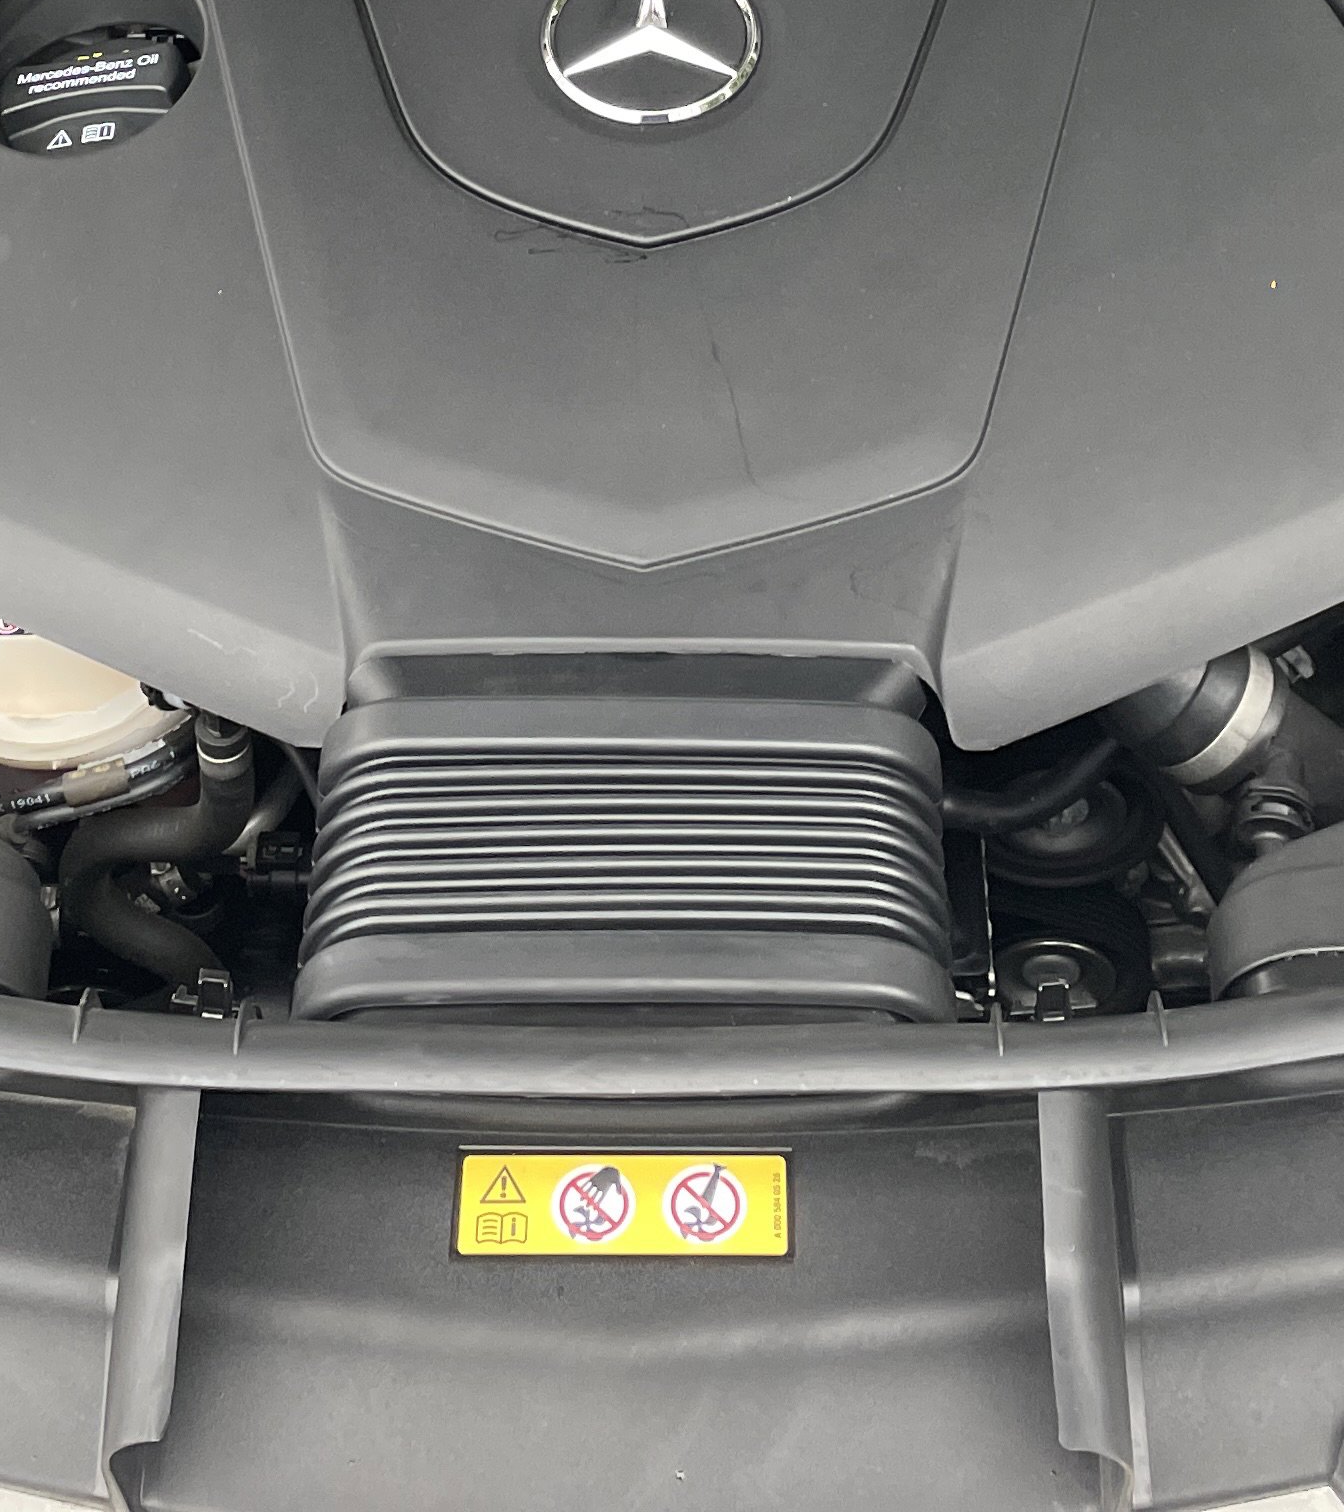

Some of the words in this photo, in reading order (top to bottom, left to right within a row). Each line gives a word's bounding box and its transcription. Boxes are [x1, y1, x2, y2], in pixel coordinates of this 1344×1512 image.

[16, 57, 134, 86] Mercedes-Benz
[136, 53, 160, 67] Oil
[28, 67, 137, 95] recommended
